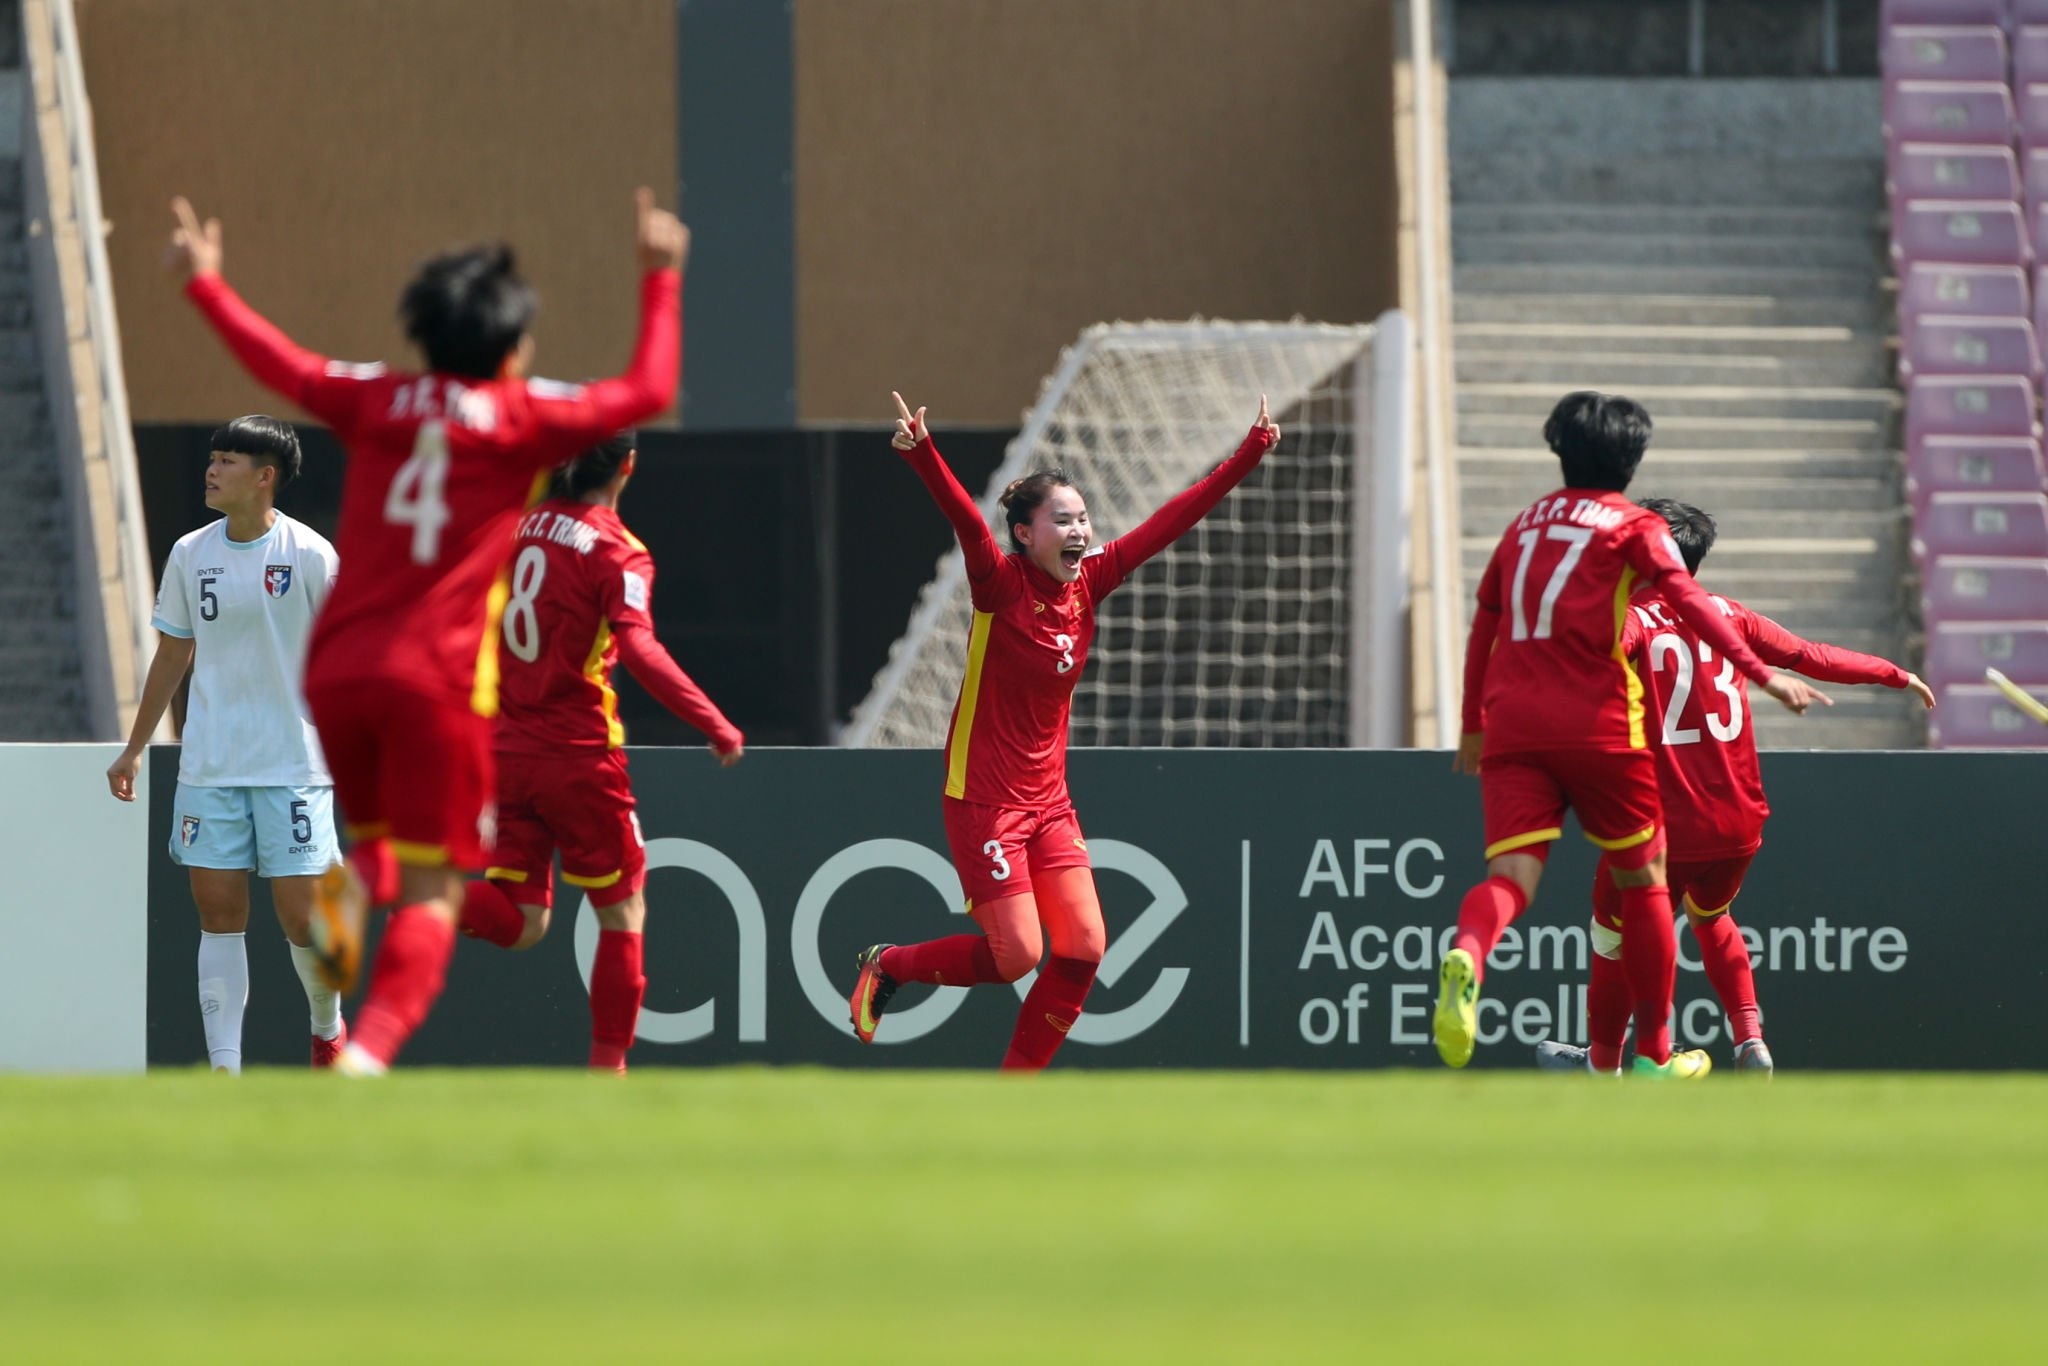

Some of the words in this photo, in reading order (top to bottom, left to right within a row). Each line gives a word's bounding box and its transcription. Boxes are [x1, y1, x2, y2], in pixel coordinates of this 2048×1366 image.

[383, 417, 449, 565] 4
[200, 578, 218, 621] 5
[503, 545, 546, 660] 8
[1511, 524, 1595, 641] 17
[1056, 633, 1075, 674] 3
[1650, 632, 1743, 745] 23
[288, 845, 318, 854] ENTES
[290, 800, 312, 844] 5
[983, 839, 1011, 881] 3
[1298, 837, 1446, 899] AFC
[1299, 982, 1369, 1045] of
